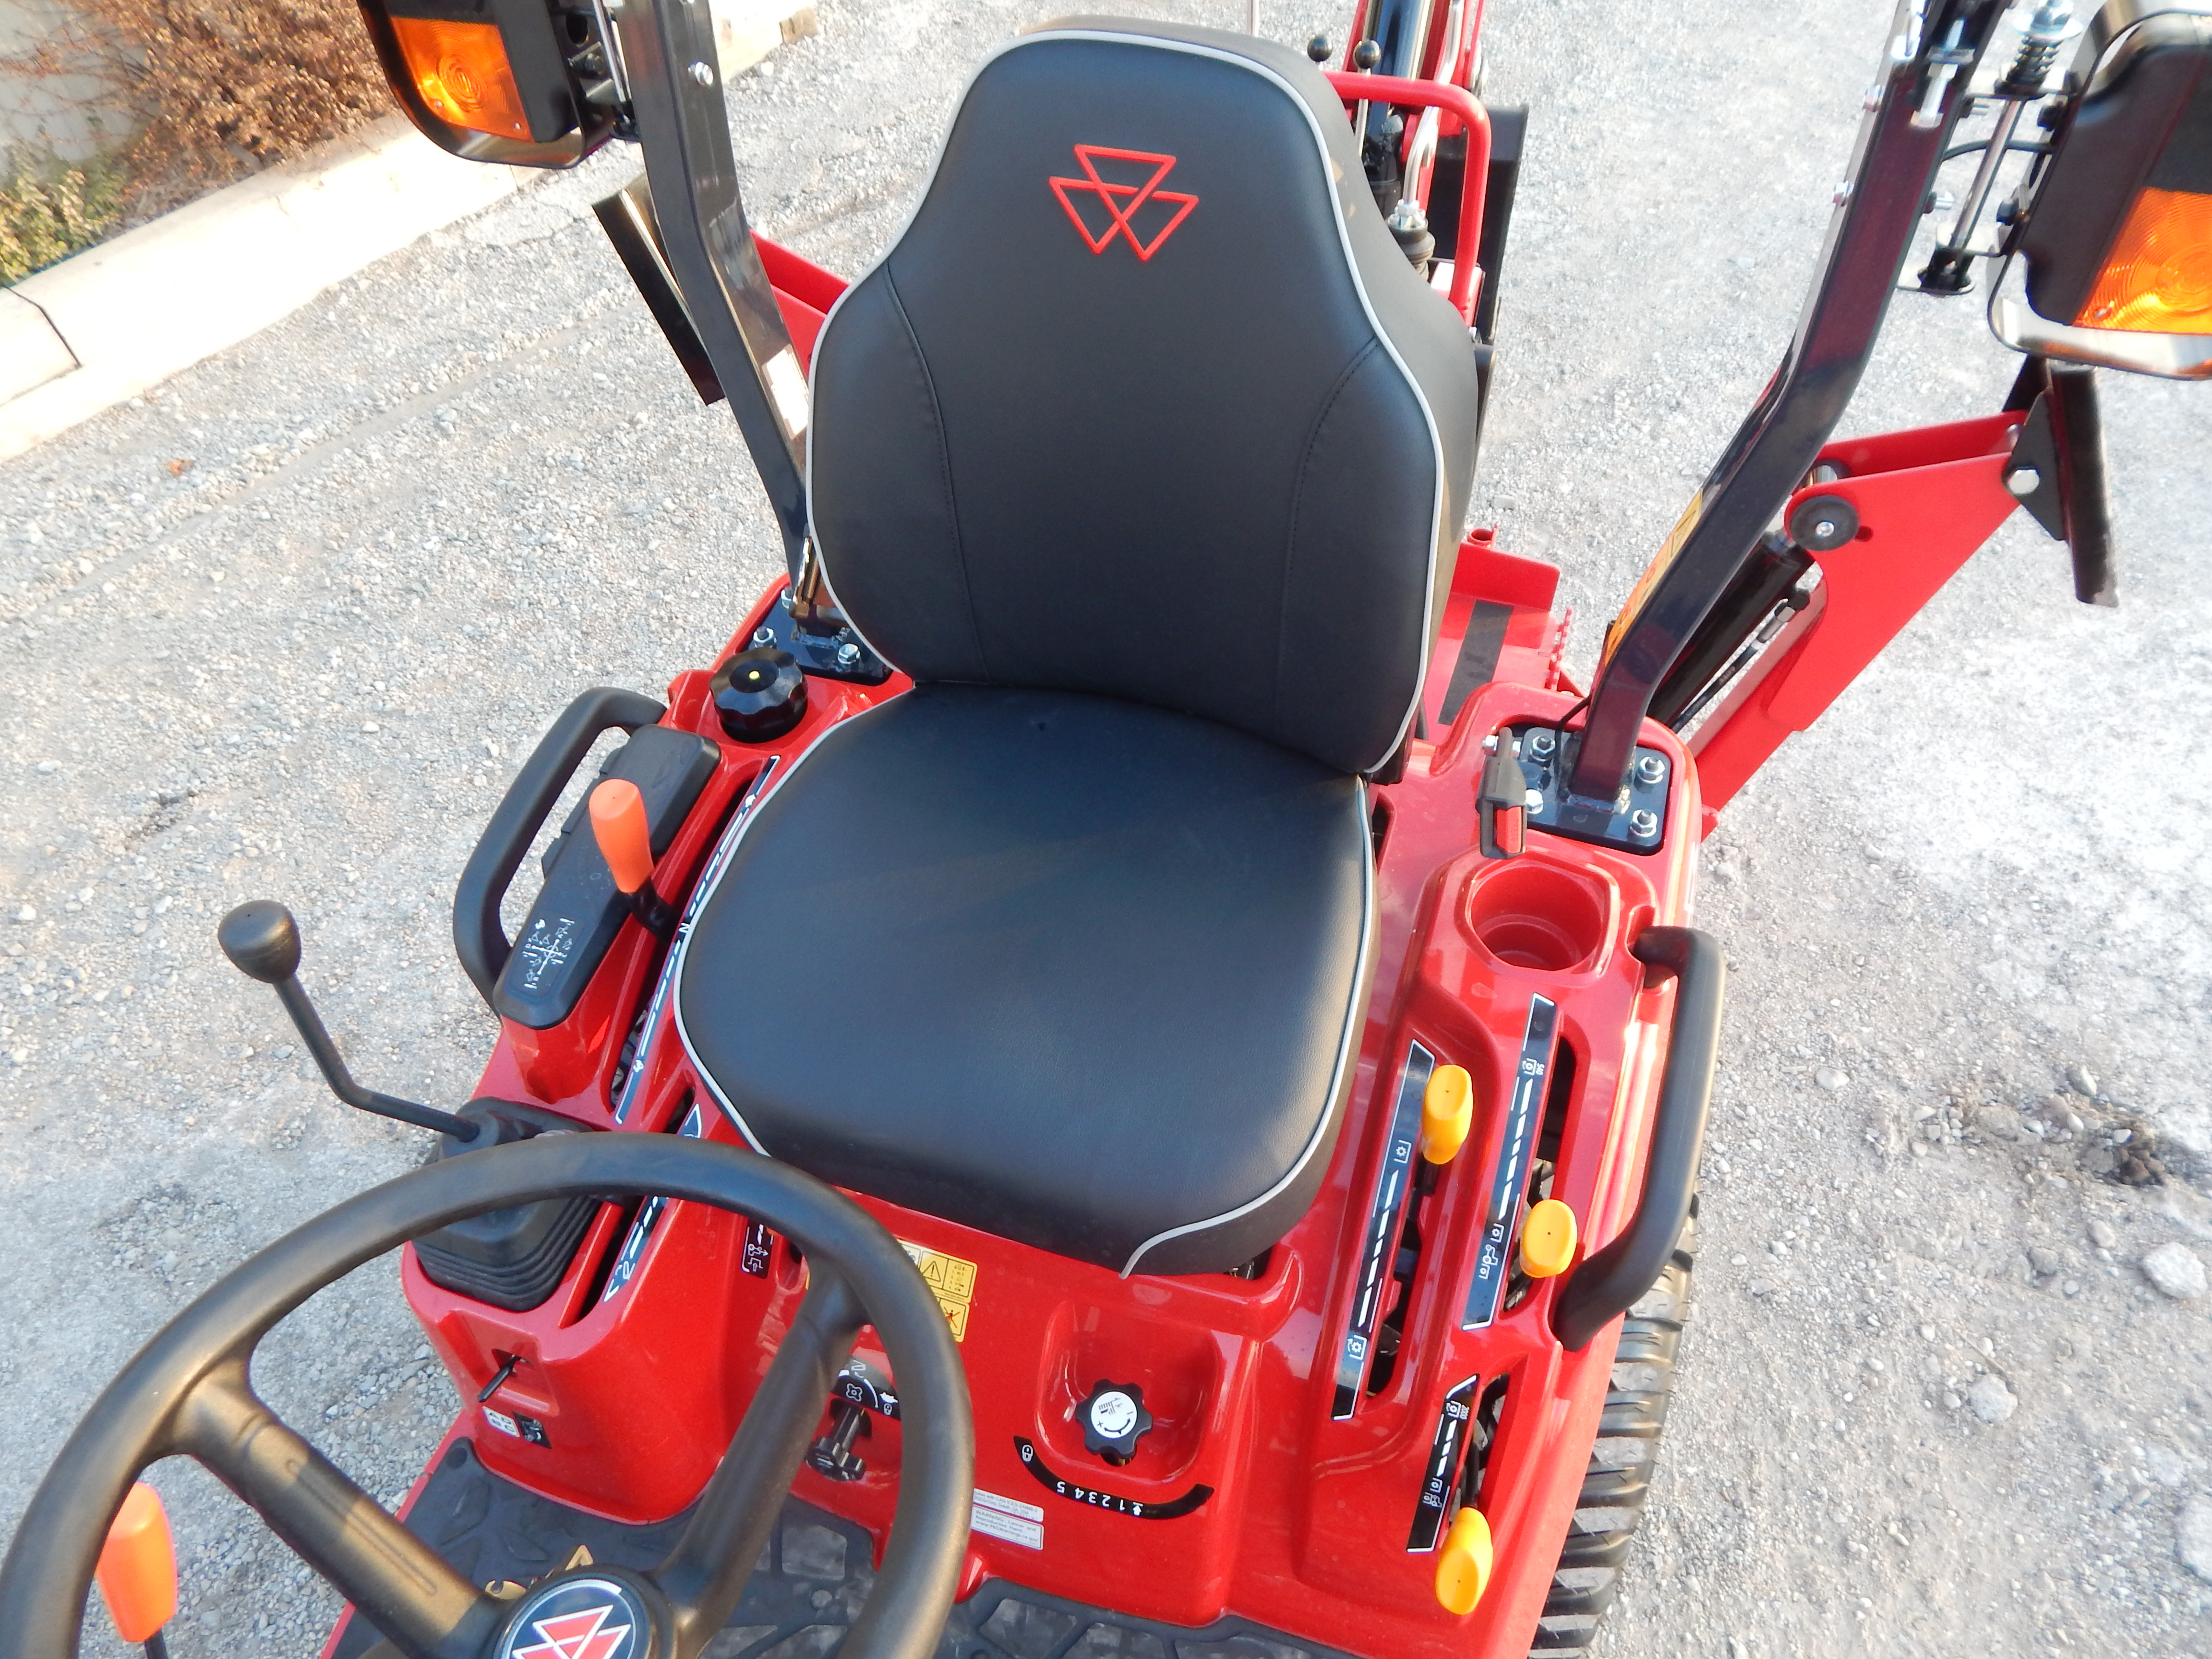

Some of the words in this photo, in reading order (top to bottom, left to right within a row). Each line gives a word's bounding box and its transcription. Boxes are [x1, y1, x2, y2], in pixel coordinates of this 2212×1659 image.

[679, 923, 690, 933] N
[1459, 1404, 1470, 1419] 2000
[1057, 1481, 1066, 1493] 5
[1075, 1487, 1084, 1499] 4
[1088, 1491, 1098, 1503] 3
[1102, 1494, 1111, 1507] 2
[1119, 1499, 1125, 1511] 1
